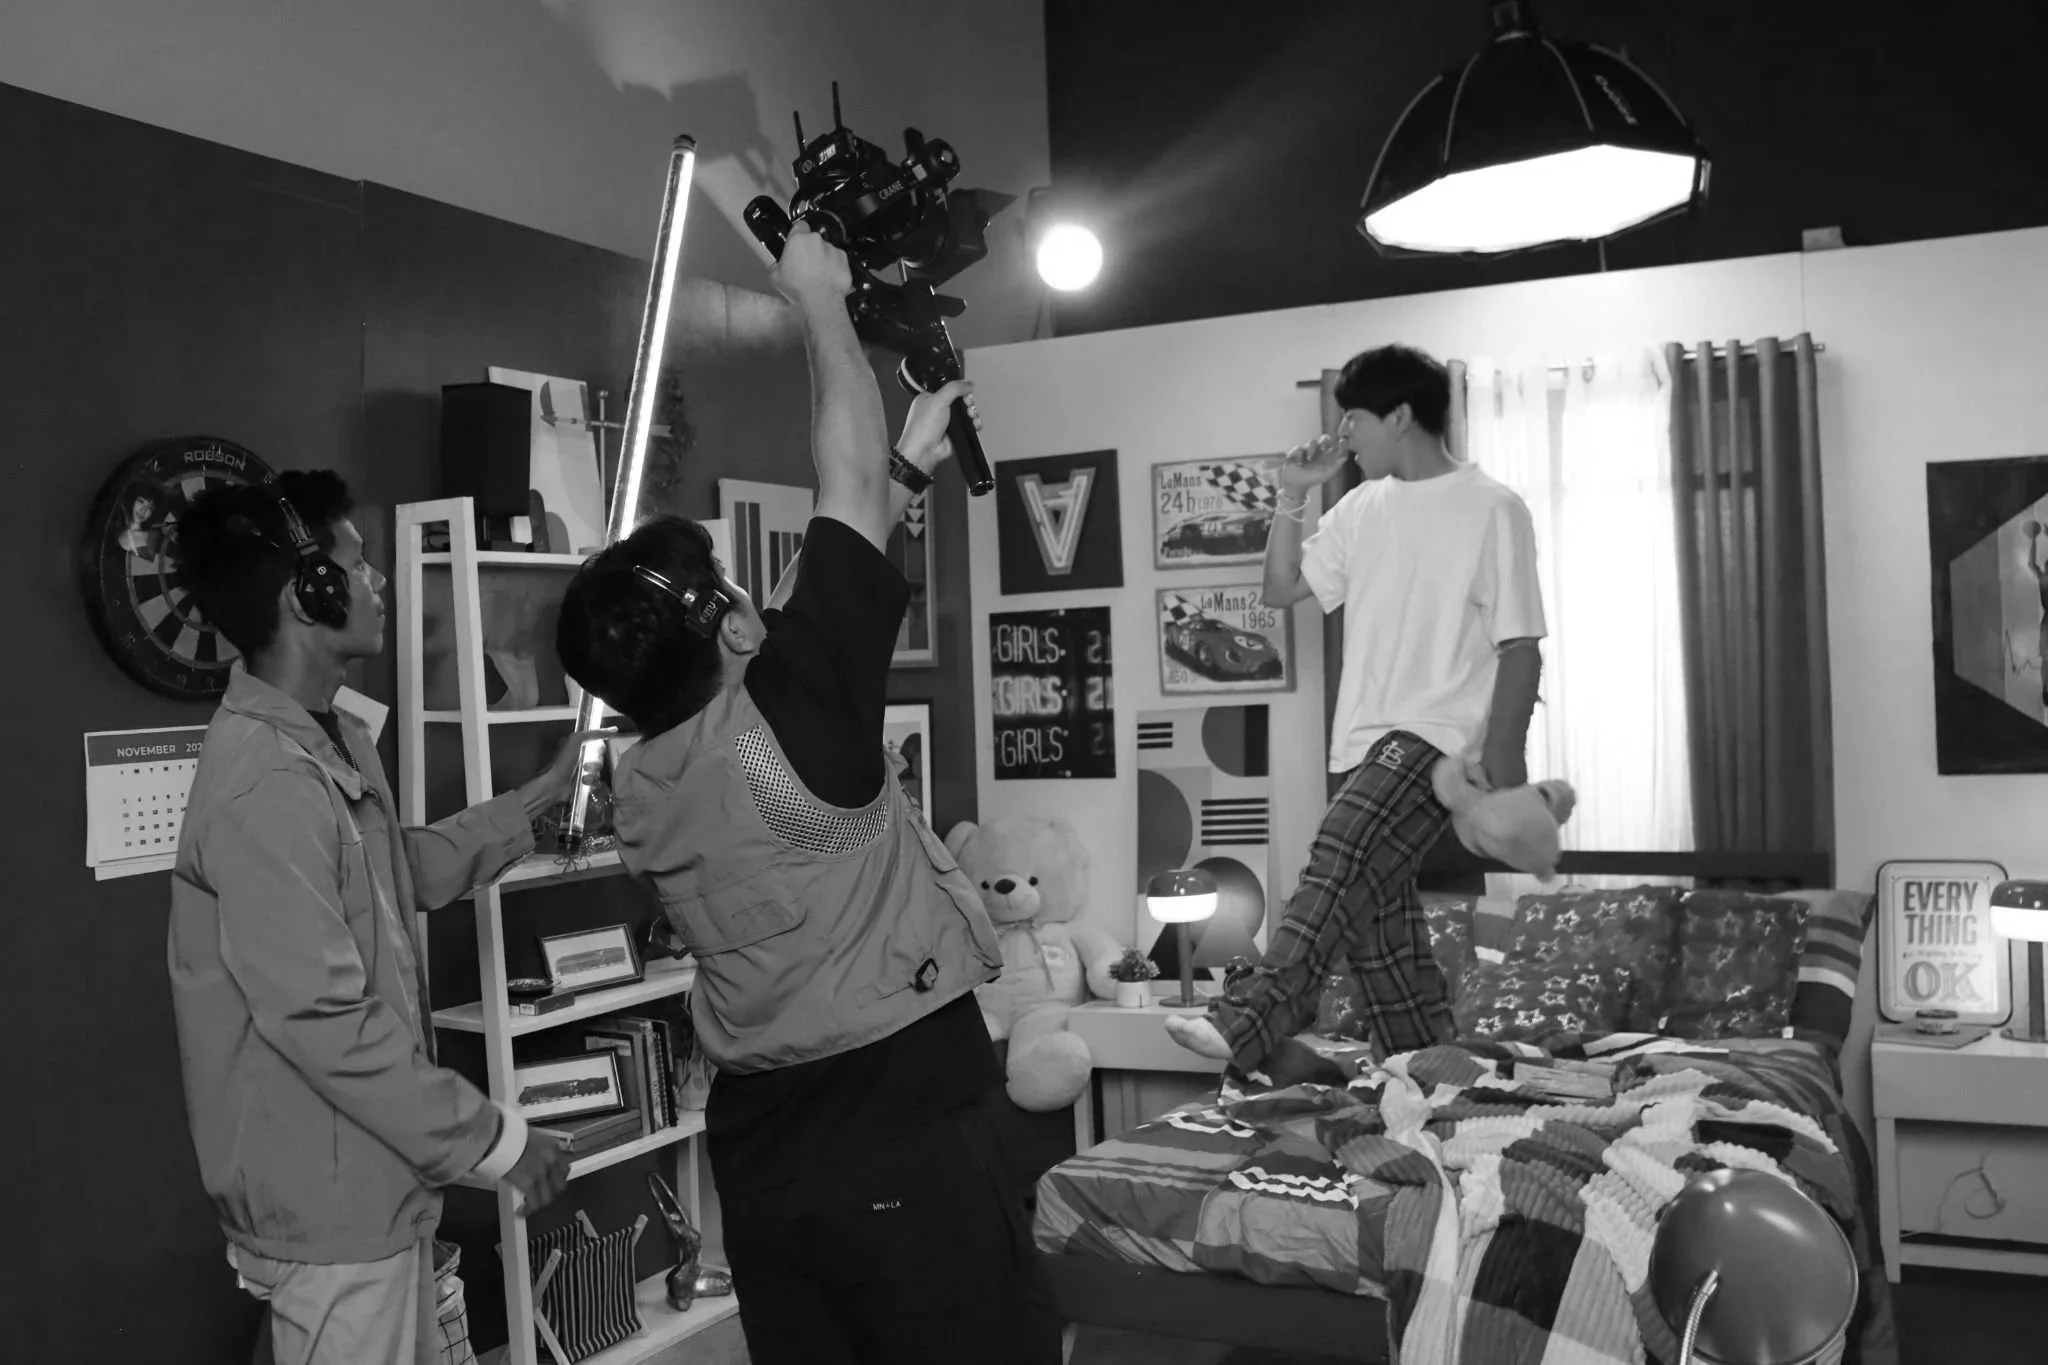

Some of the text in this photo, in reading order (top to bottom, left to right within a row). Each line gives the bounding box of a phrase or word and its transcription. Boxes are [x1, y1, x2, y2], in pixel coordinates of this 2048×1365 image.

[879, 180, 904, 200] CRANE
[997, 624, 1060, 664] GIRLS
[117, 742, 202, 758] NOVEMBER 202
[1001, 726, 1064, 767] GIRLS
[1903, 881, 1979, 912] EVERY
[1904, 913, 1977, 945] THING
[1903, 960, 1984, 1002] OK
